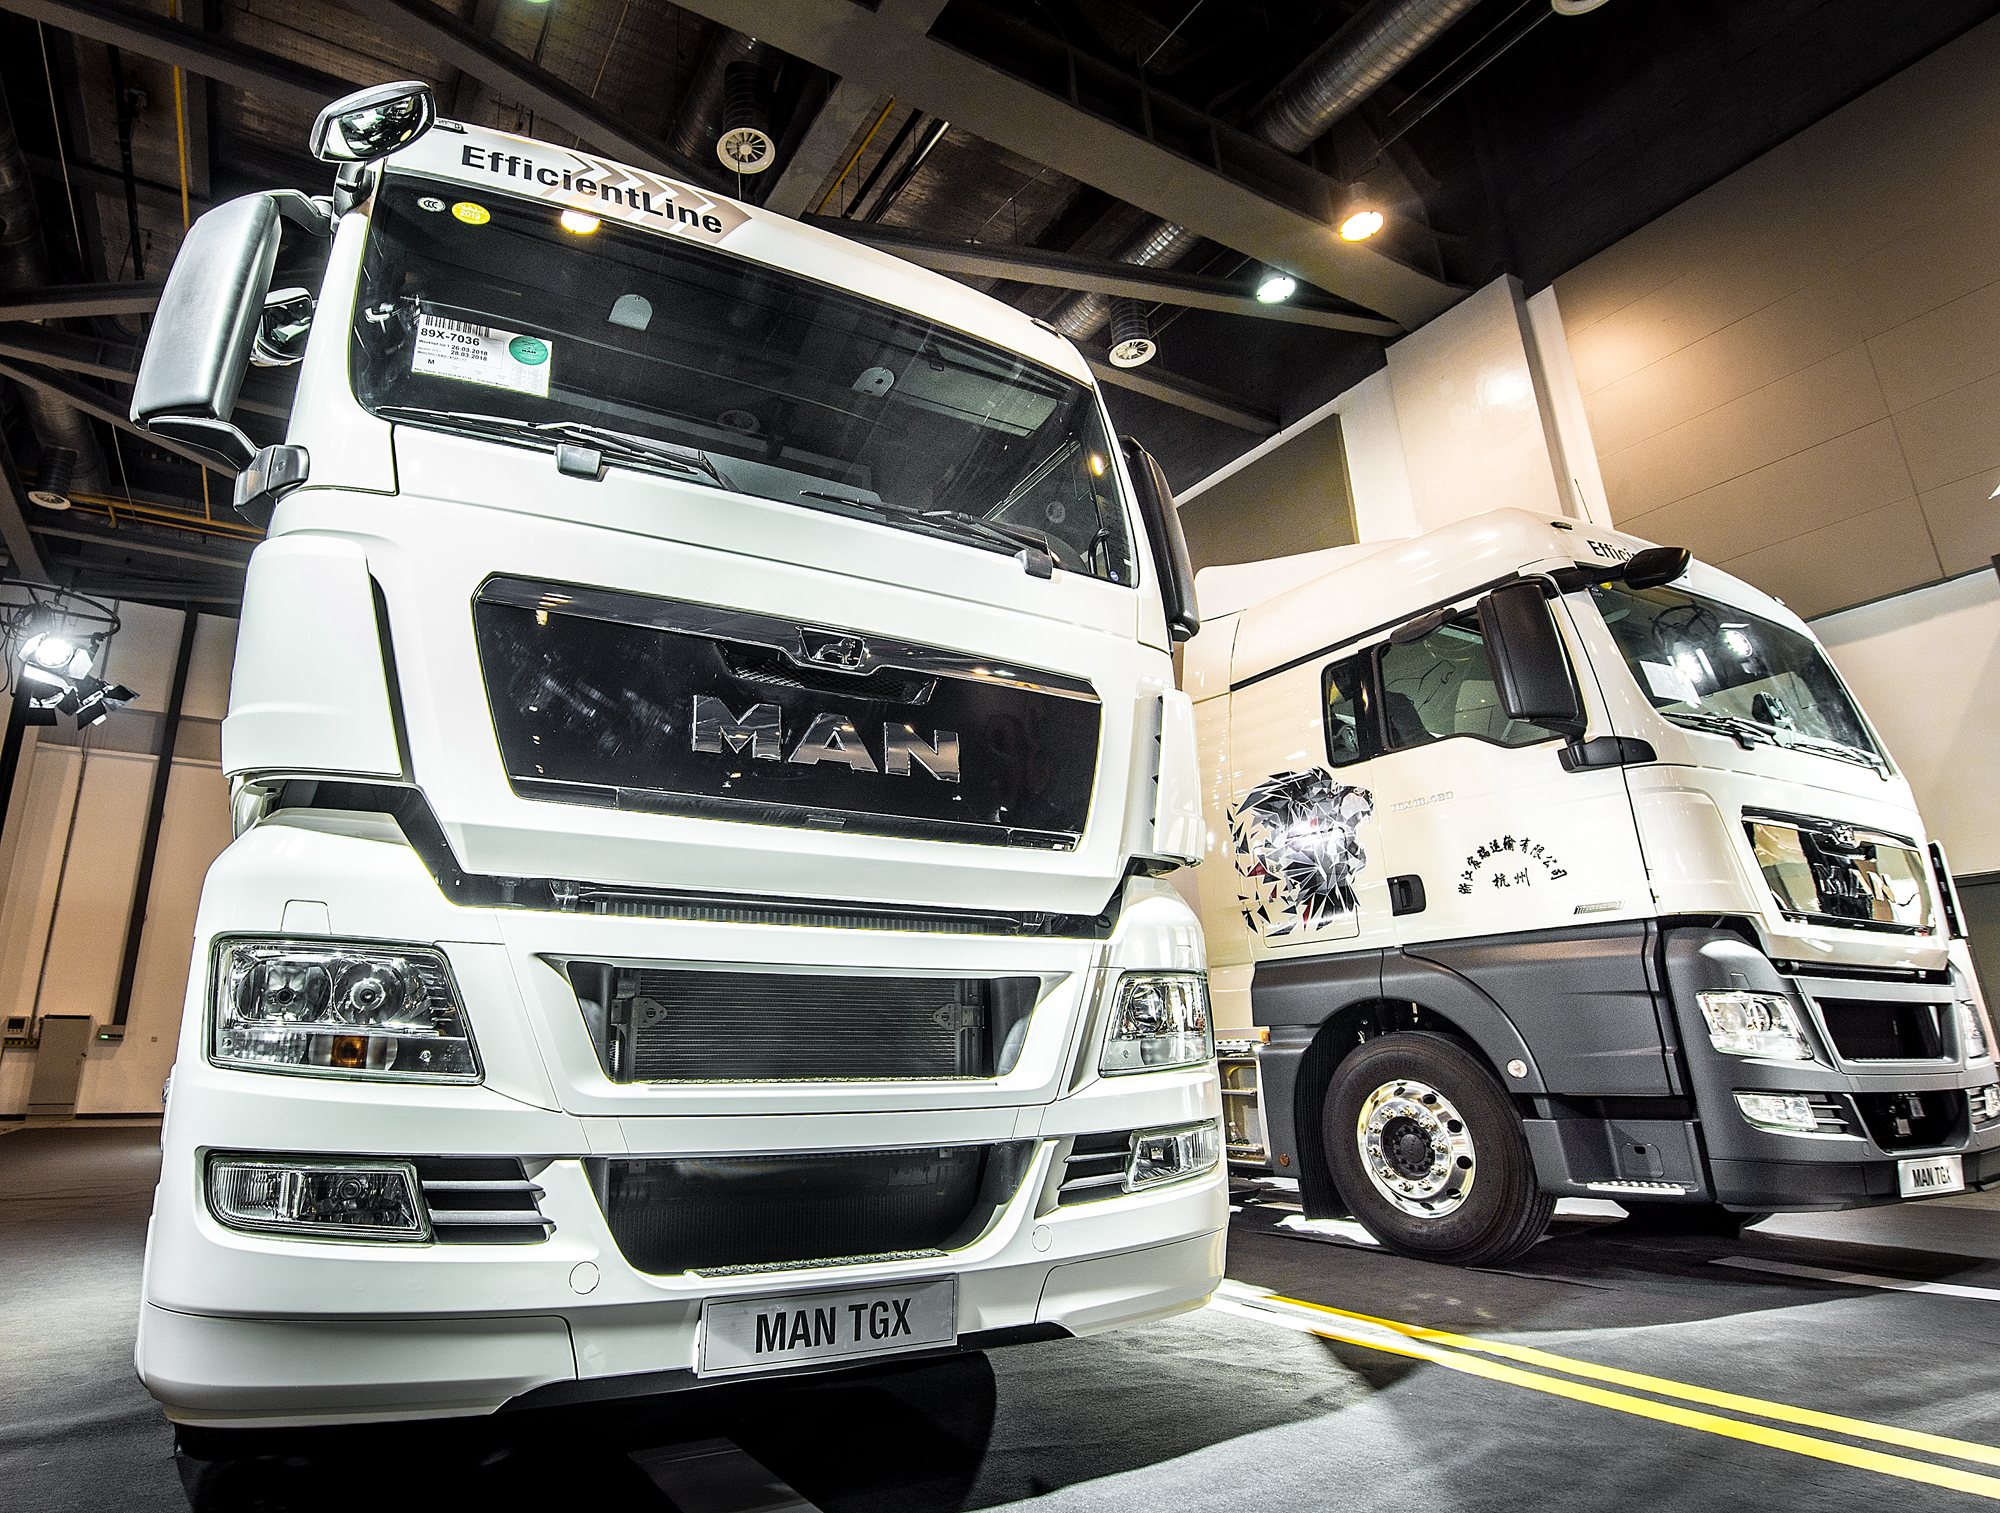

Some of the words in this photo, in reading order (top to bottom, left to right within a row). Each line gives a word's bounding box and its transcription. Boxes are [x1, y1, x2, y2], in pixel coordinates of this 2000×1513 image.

[461, 144, 723, 234] EfficientLine
[420, 327, 480, 346] 89X-7036
[450, 350, 488, 361] 28.03.2018
[451, 344, 488, 356] 26.03.2018
[691, 694, 961, 783] MAN
[1492, 867, 1530, 889] 杭州
[1912, 1167, 1935, 1188] MAN
[756, 1307, 836, 1353] MAN
[848, 1298, 912, 1342] TGX
